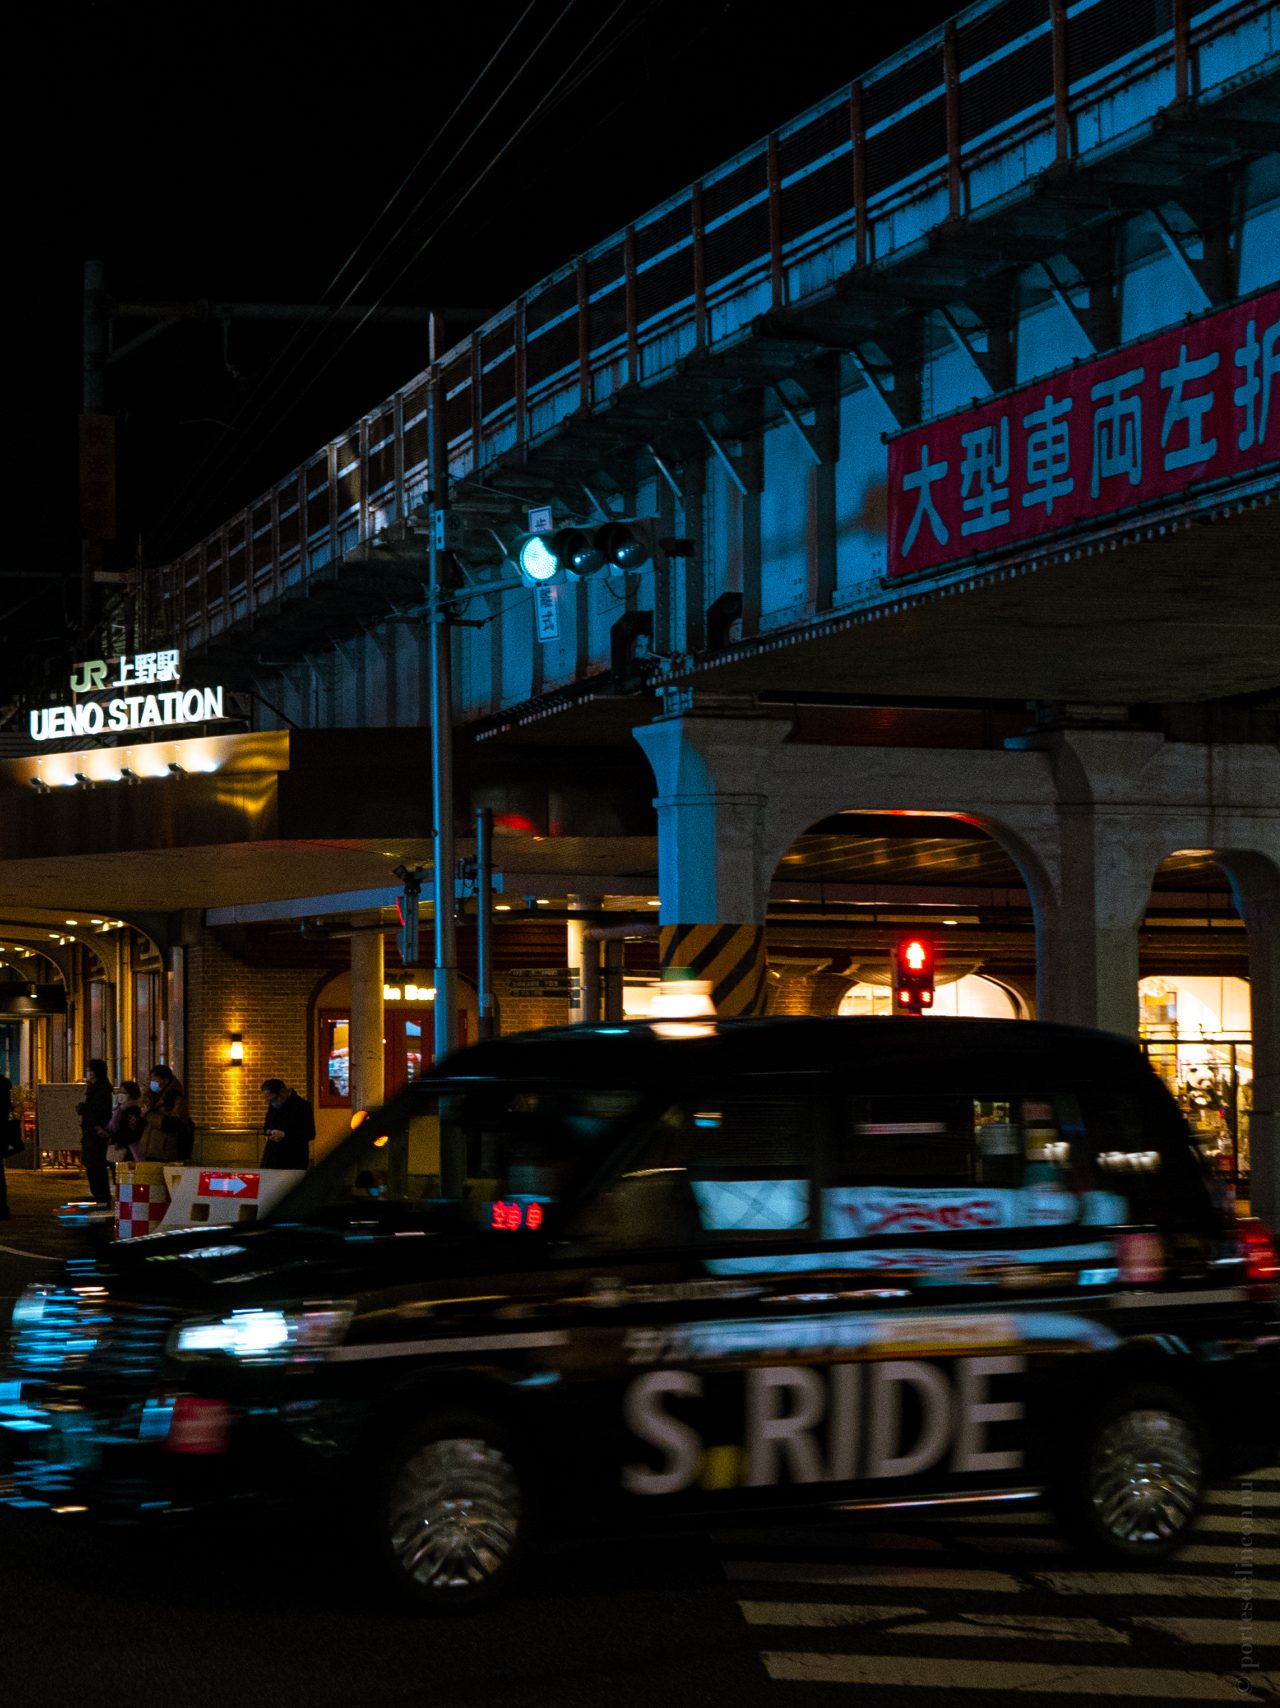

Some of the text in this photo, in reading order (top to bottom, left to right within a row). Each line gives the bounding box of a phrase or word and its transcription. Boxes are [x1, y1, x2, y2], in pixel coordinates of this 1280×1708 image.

[901, 319, 1280, 558] 大型車両左折
[70, 649, 181, 693] JR 上野駅
[30, 686, 224, 741] UENO STATION
